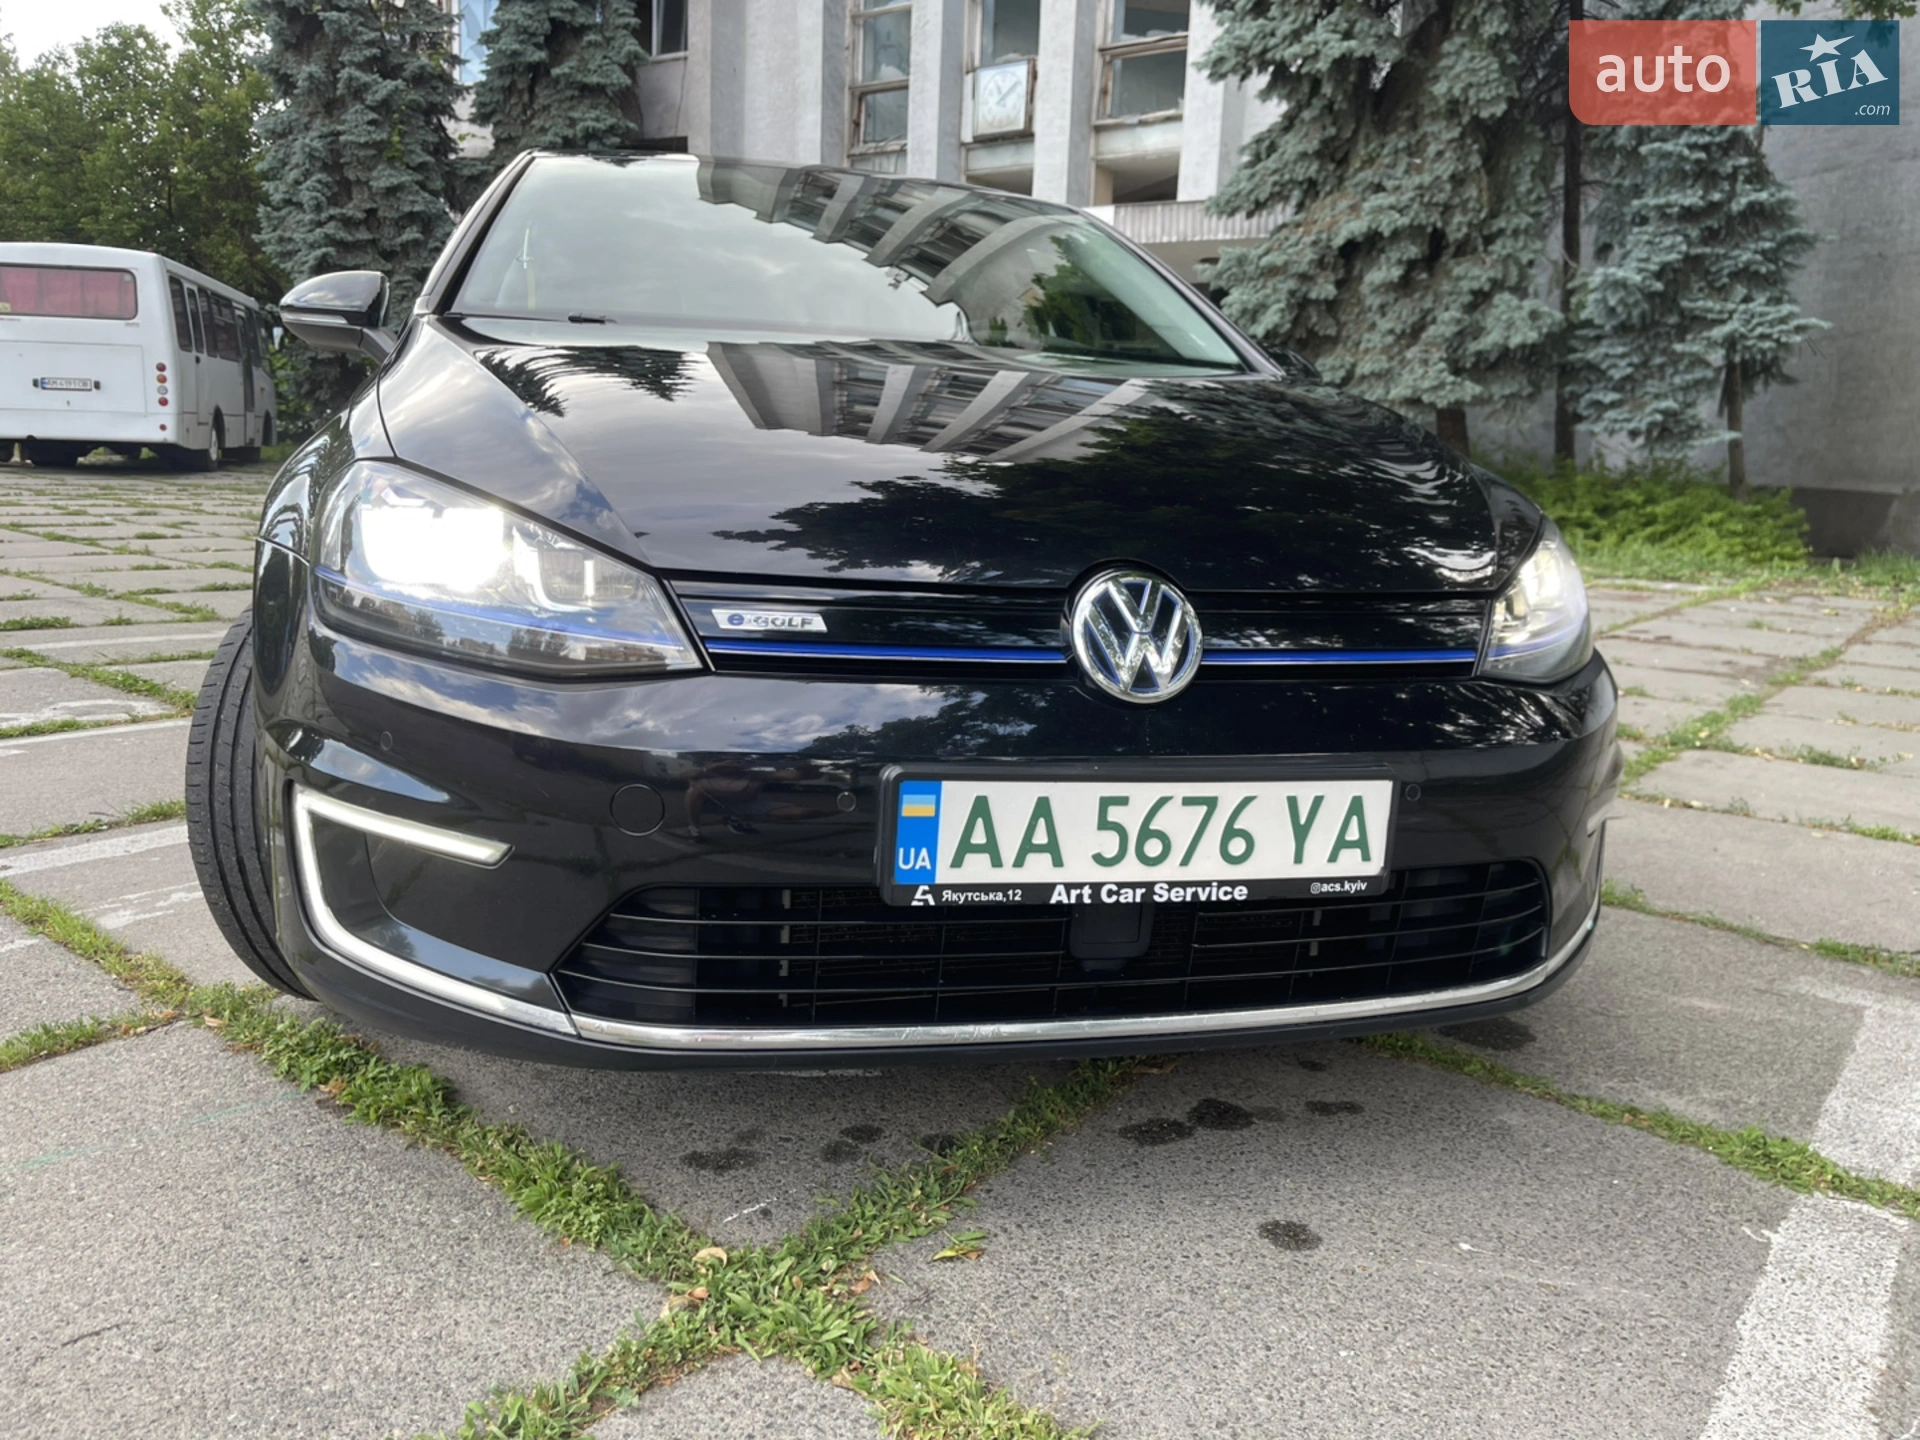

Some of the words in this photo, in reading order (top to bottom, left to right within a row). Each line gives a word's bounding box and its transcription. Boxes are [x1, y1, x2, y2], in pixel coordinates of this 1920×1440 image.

[949, 795, 1064, 868] AA
[1090, 795, 1258, 868] 5676
[1286, 794, 1372, 864] YA
[898, 847, 932, 870] UA
[1049, 884, 1092, 904] Art
[1099, 883, 1146, 904] Car
[1152, 881, 1249, 903] Service
